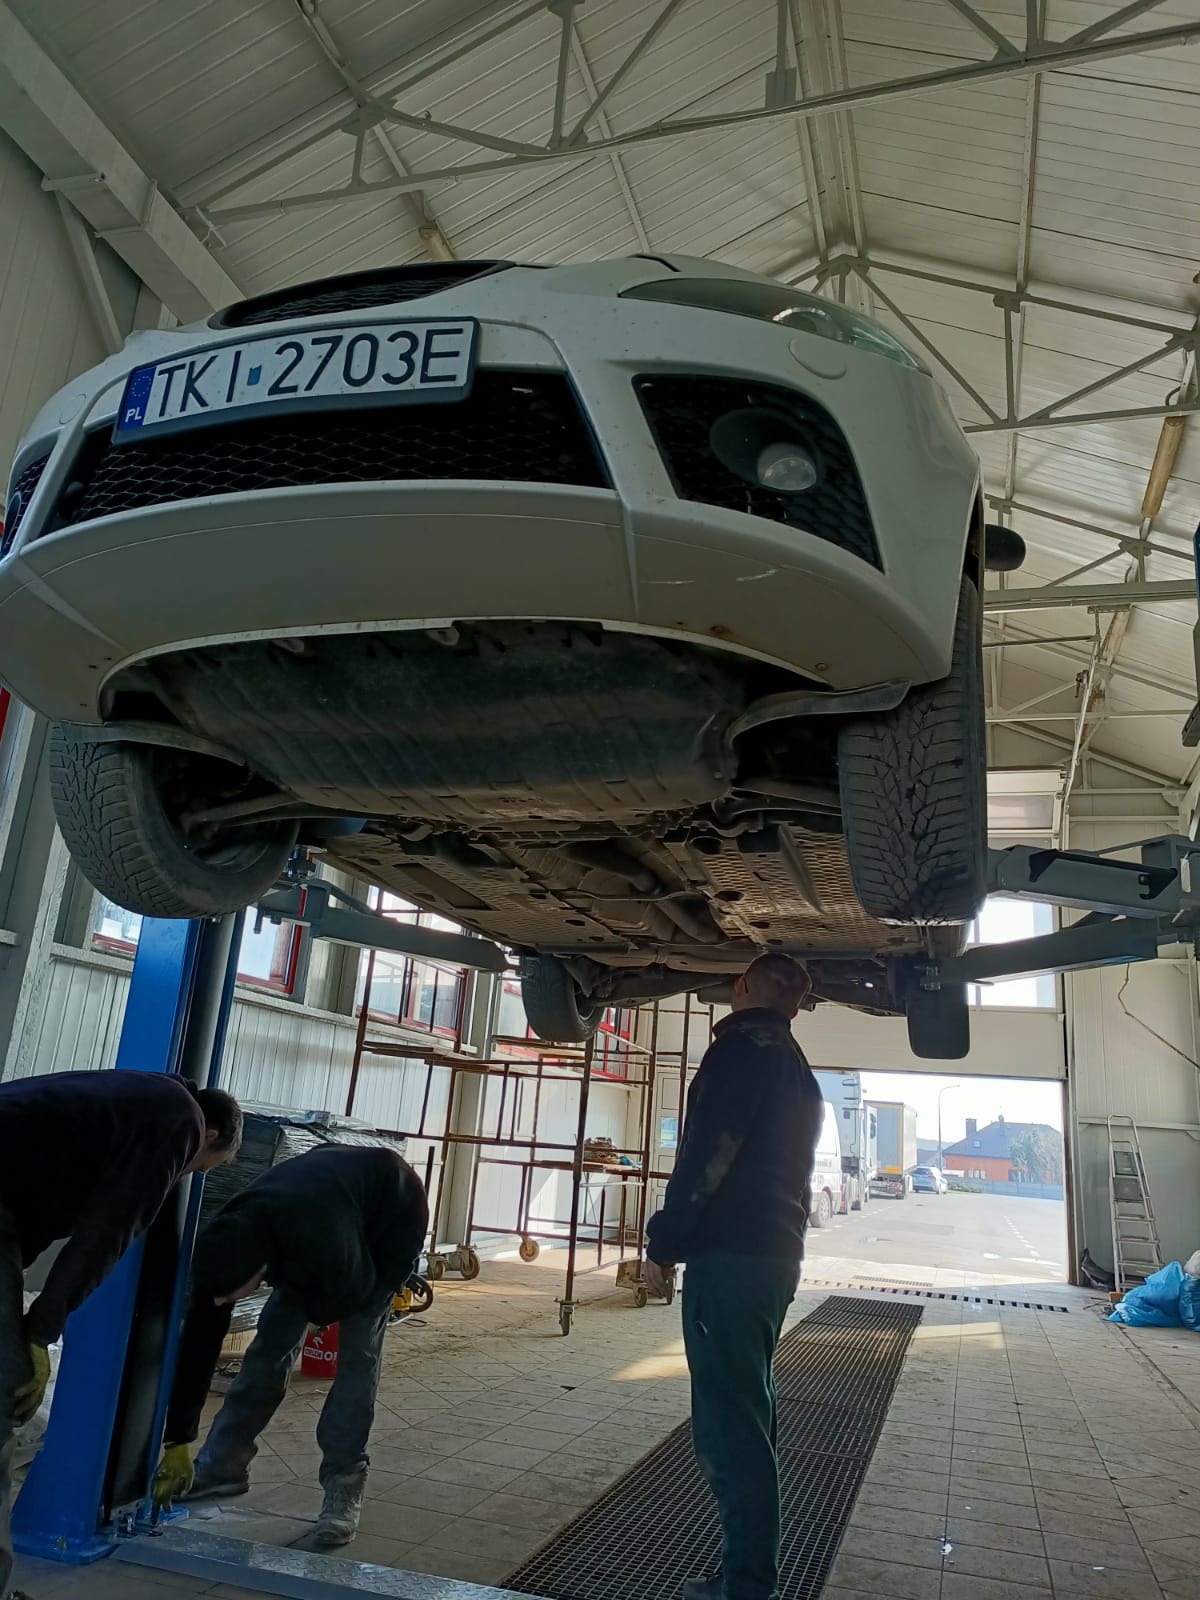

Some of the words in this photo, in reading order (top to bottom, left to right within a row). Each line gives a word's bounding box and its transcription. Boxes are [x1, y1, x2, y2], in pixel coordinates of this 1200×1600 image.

[158, 350, 242, 417] TKI
[267, 328, 464, 396] 2703E
[125, 407, 142, 422] PL
